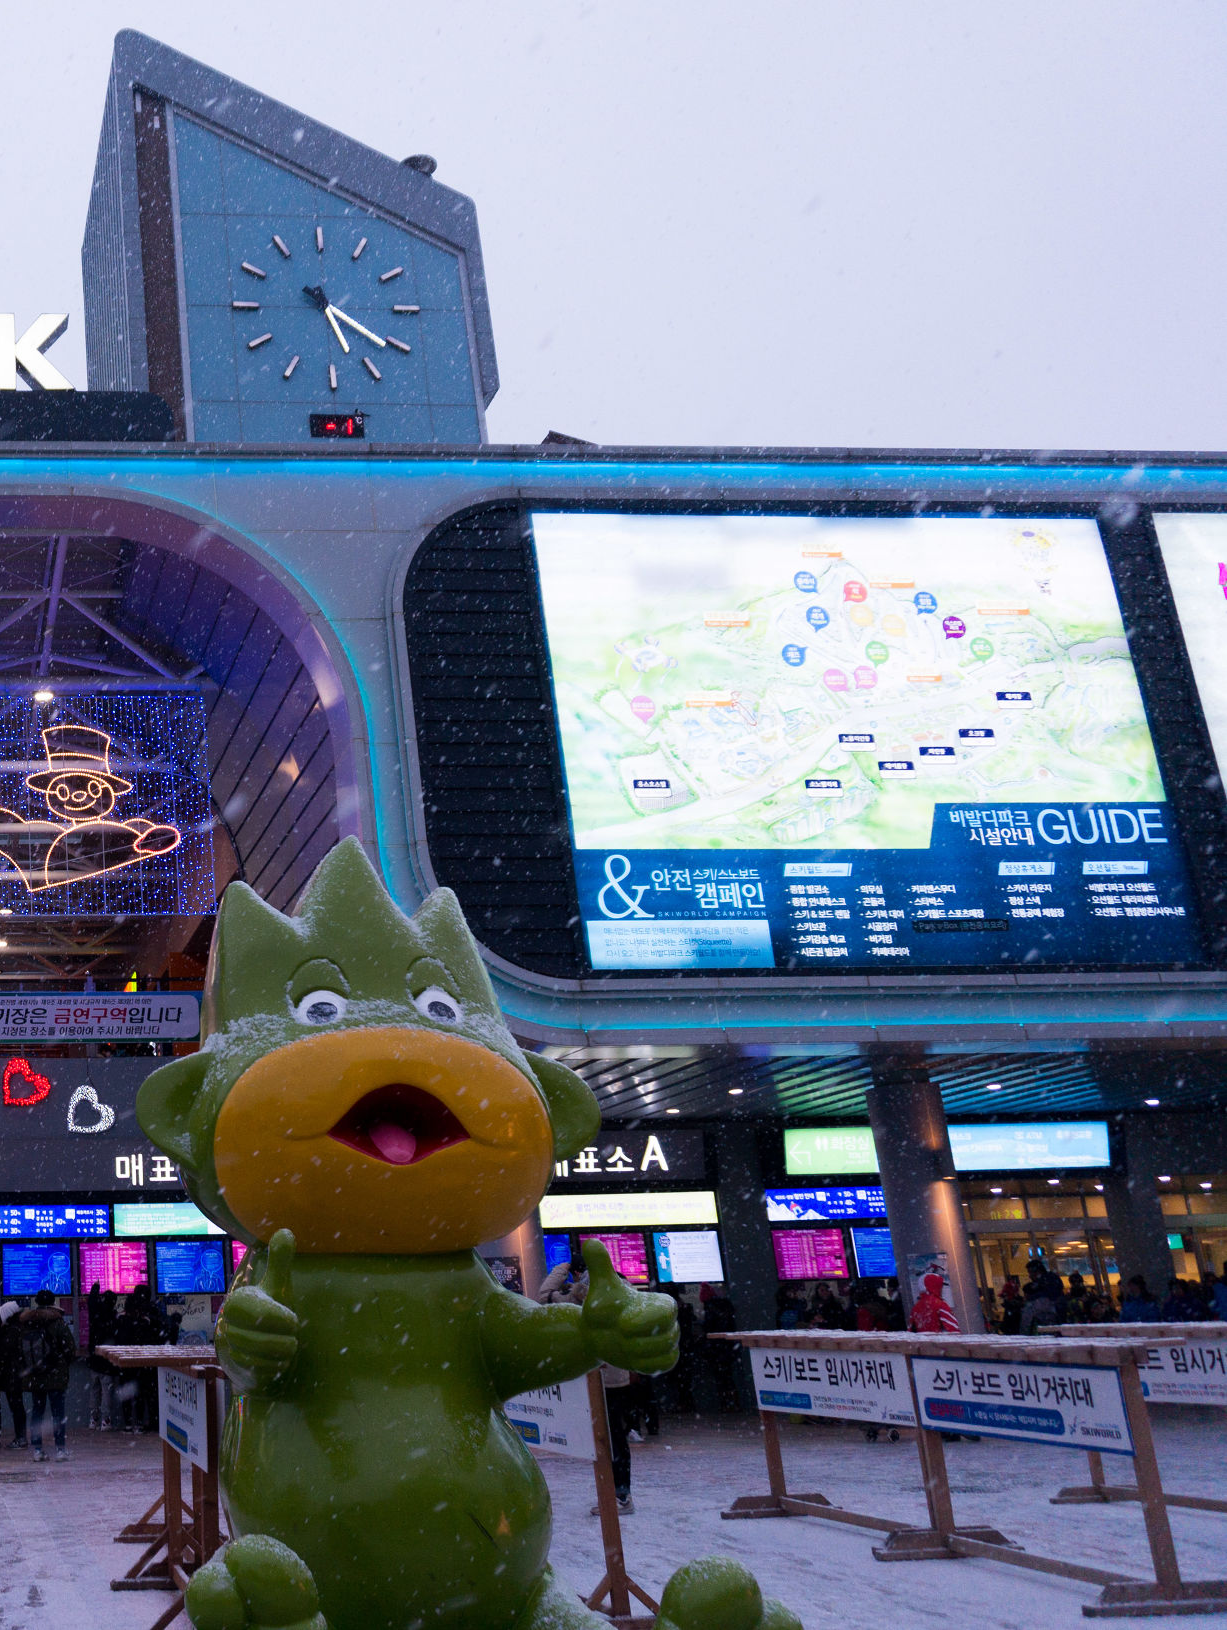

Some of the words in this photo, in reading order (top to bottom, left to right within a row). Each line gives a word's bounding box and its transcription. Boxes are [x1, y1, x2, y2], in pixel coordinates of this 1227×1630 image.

[948, 809, 1032, 827] 비발디파크
[1036, 808, 1169, 845] GUIDE
[969, 828, 1036, 846] 시설안내
[651, 868, 693, 892] 안전
[692, 868, 762, 881] 스키/스노보드
[695, 881, 767, 909] 캠페인
[54, 1006, 183, 1026] 금연구역입니다
[1, 1026, 27, 1037] 지정된
[30, 1026, 56, 1037] 장소를
[58, 1026, 95, 1037] 이용하여
[97, 1026, 124, 1037] 주시기
[125, 1025, 161, 1036] 바랍니다
[640, 1135, 669, 1172] A
[829, 1135, 870, 1151] 화장실
[1170, 1347, 1227, 1374] 임시거
[763, 1355, 822, 1383] 스키/보드
[825, 1358, 896, 1391] 임시거치대
[933, 1369, 1004, 1396] 스키·보드
[1007, 1373, 1095, 1408] 임시거치대
[1081, 1426, 1122, 1439] SKIWORLD
